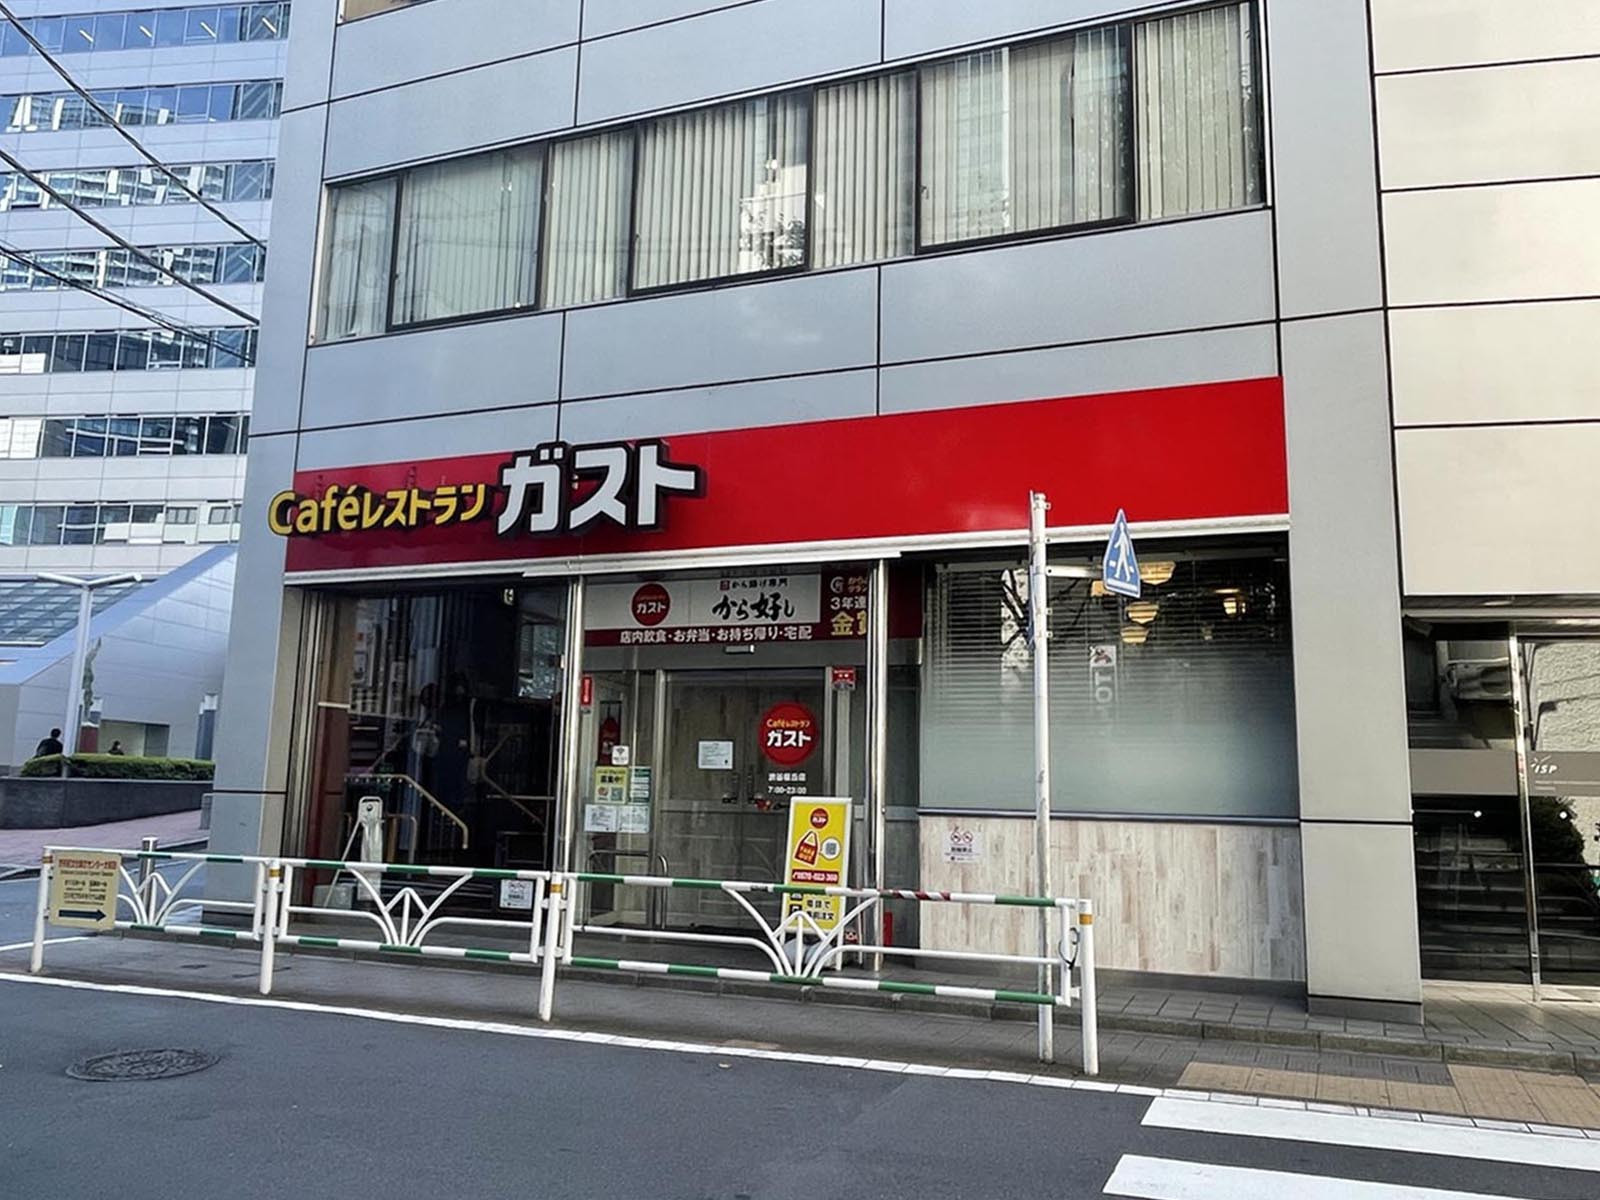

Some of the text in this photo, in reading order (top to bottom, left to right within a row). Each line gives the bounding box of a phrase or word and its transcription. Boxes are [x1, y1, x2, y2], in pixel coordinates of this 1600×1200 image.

[268, 444, 698, 536] Caféレストラン ガスト
[636, 601, 666, 614] ガスト
[712, 592, 796, 621] から好し
[766, 730, 812, 748] ガスト
